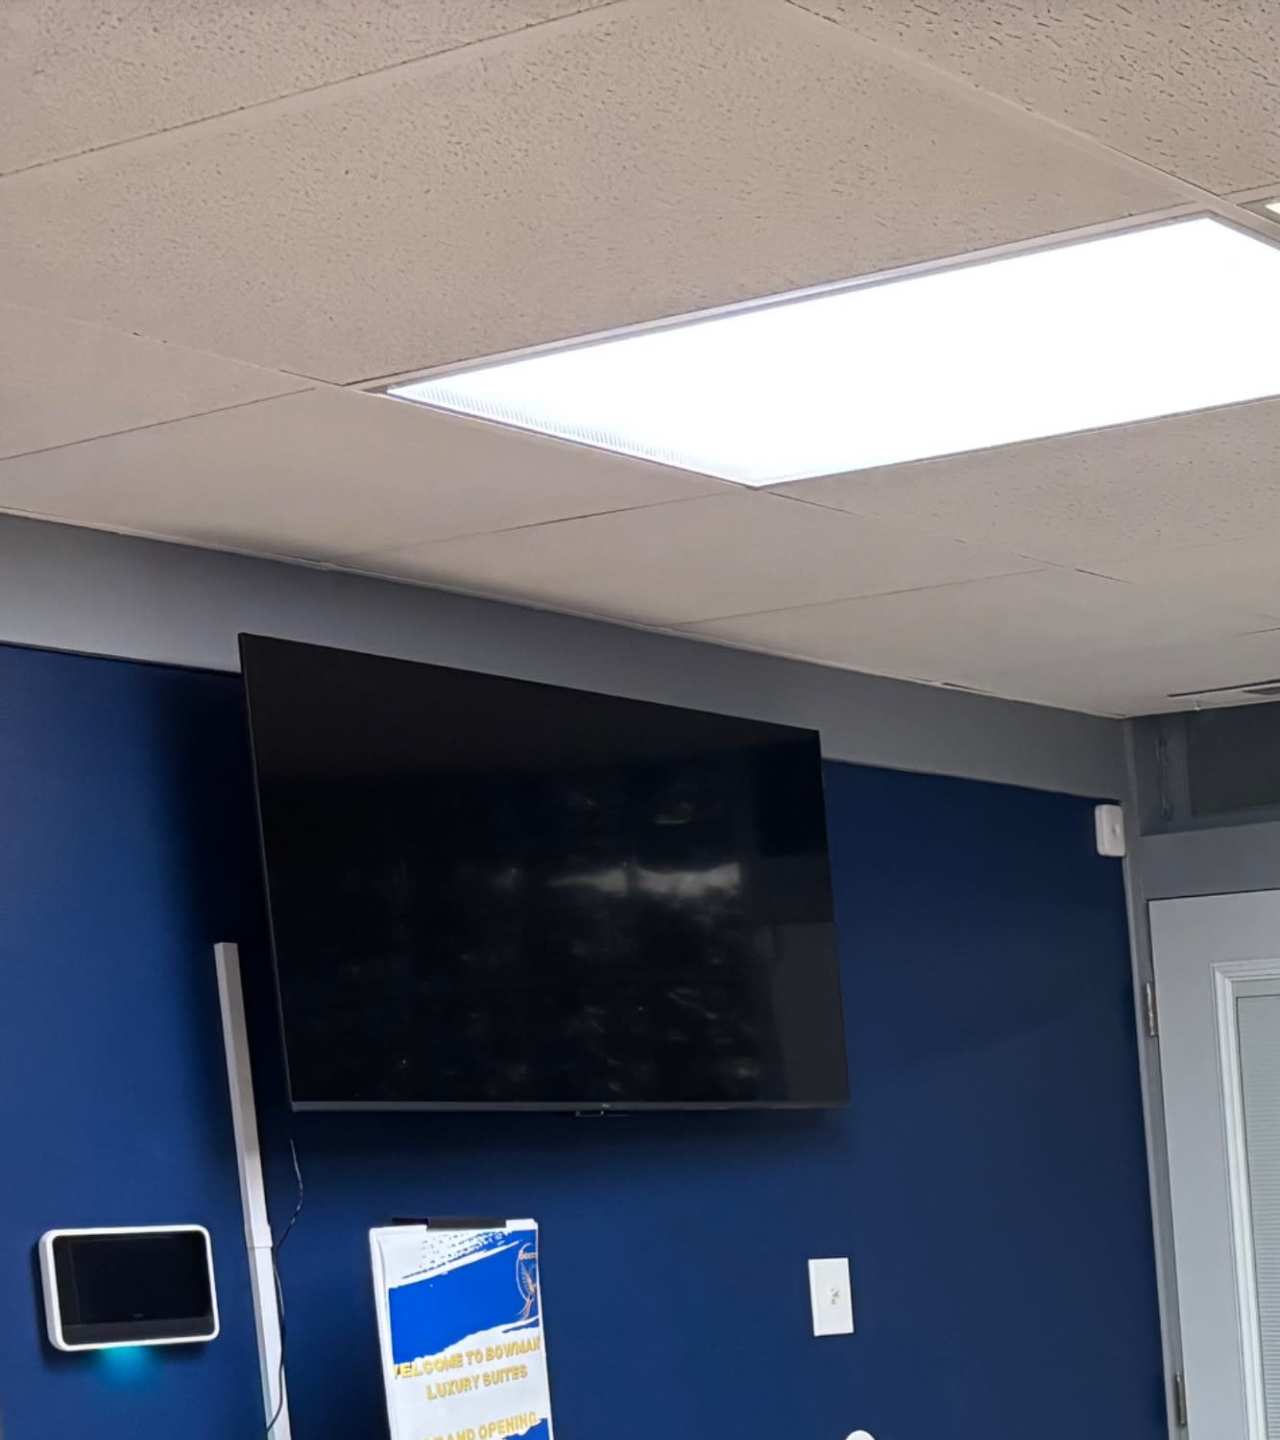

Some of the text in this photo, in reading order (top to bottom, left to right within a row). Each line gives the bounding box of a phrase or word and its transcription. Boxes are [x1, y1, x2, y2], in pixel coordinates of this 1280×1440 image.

[465, 1348, 484, 1367] TO
[425, 1364, 528, 1401] LUXURY SUITES
[478, 1411, 538, 1440] OPENING
